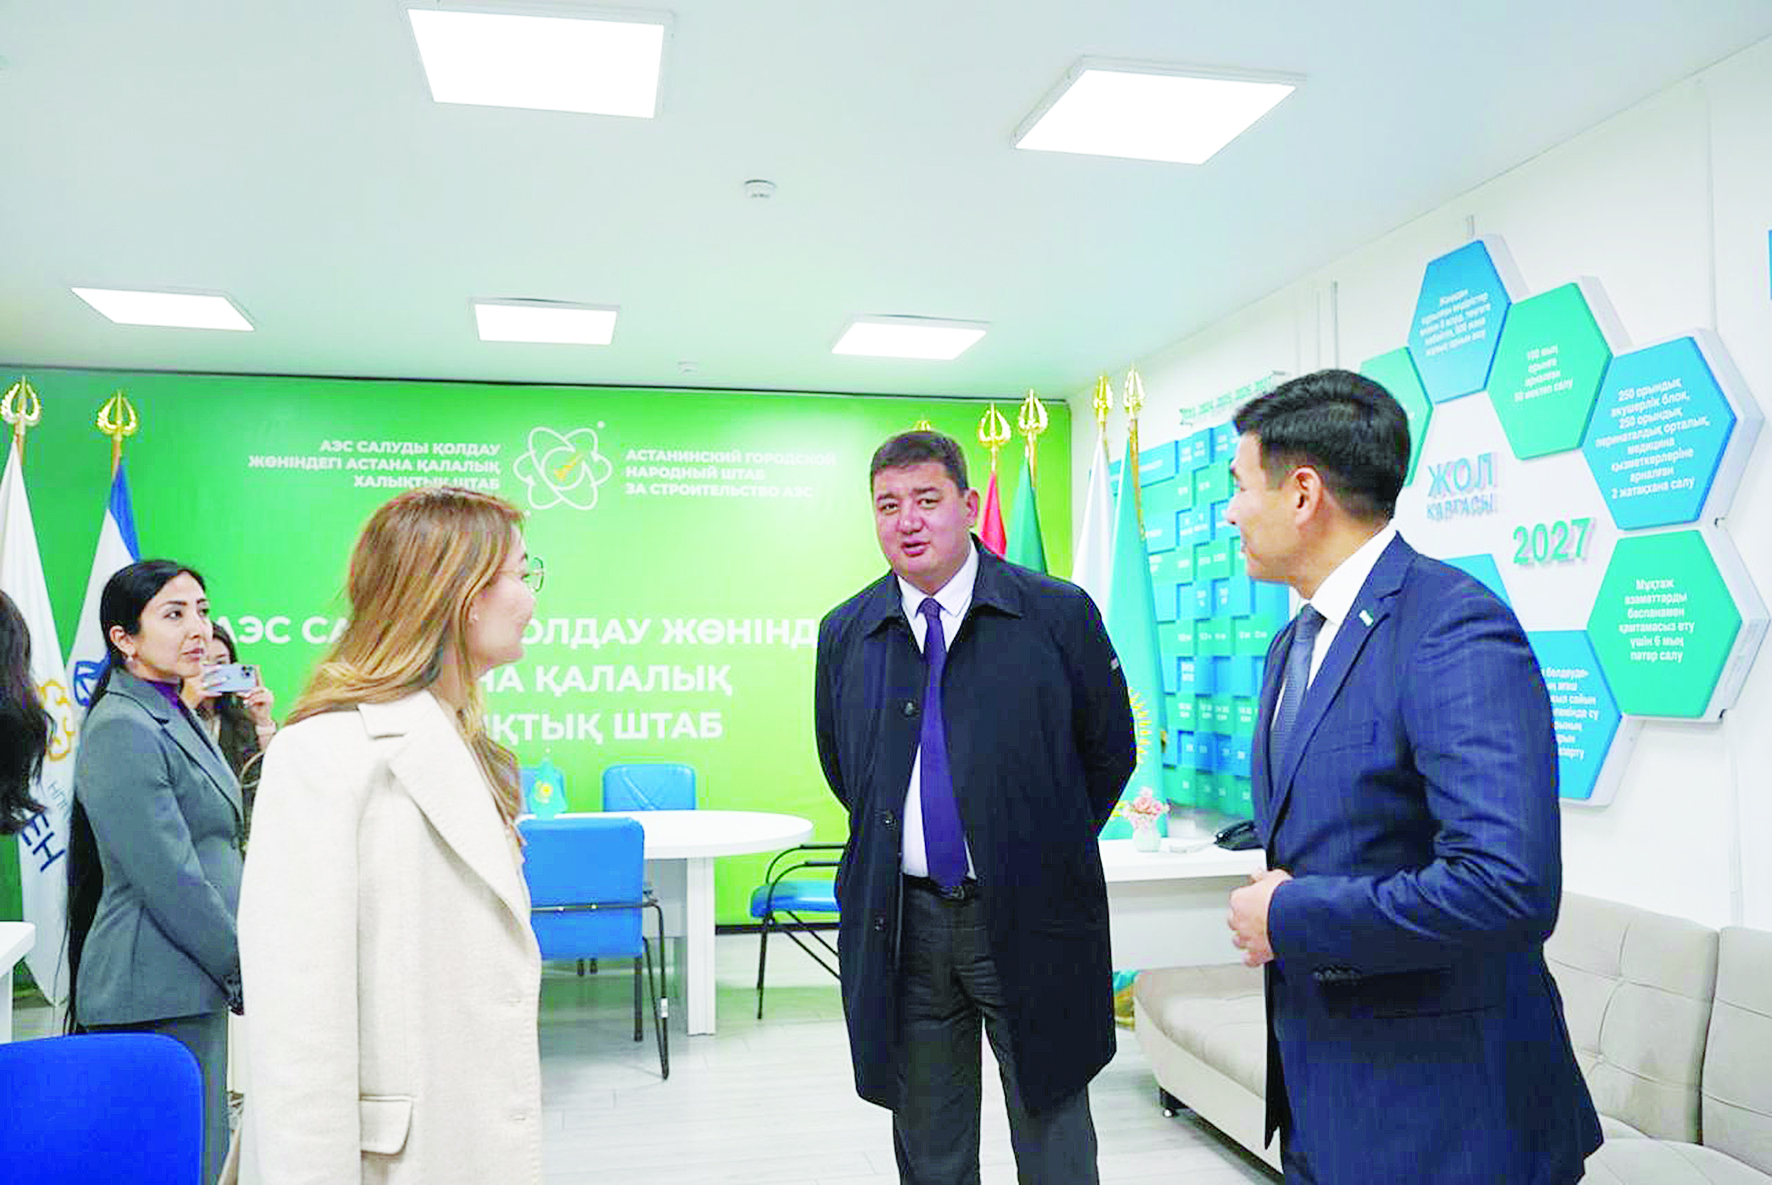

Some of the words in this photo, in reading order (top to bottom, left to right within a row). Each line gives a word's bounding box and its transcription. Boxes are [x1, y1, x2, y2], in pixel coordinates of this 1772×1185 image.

[320, 440, 353, 453] АЭС
[357, 441, 429, 455] САЛУДЫ
[432, 443, 500, 457] ҚОЛДАУ
[625, 449, 742, 464] АСТАНИНСКИЙ
[745, 451, 836, 467] ГОРОДСКОЙ
[248, 455, 342, 471] ЖӨНІНДЕГІ
[346, 457, 412, 471] АСТАНА
[417, 460, 500, 475] ҚАЛАЛЫҚ
[625, 464, 718, 480] НАРОДНЫЙ
[721, 467, 766, 481] ШТАБ
[1427, 452, 1495, 498] ЖОЛ
[625, 483, 646, 496] ЗА
[649, 484, 778, 498] СТРОИТЕЛЬСТВО
[781, 486, 814, 499] АЭС
[1513, 517, 1591, 565] 2027
[520, 617, 652, 650] ОЛДАУ
[661, 618, 819, 650] ЖӨНІНД
[535, 664, 733, 698] ҚАЛАЛЫҚ
[613, 711, 724, 741] ШТАБ
